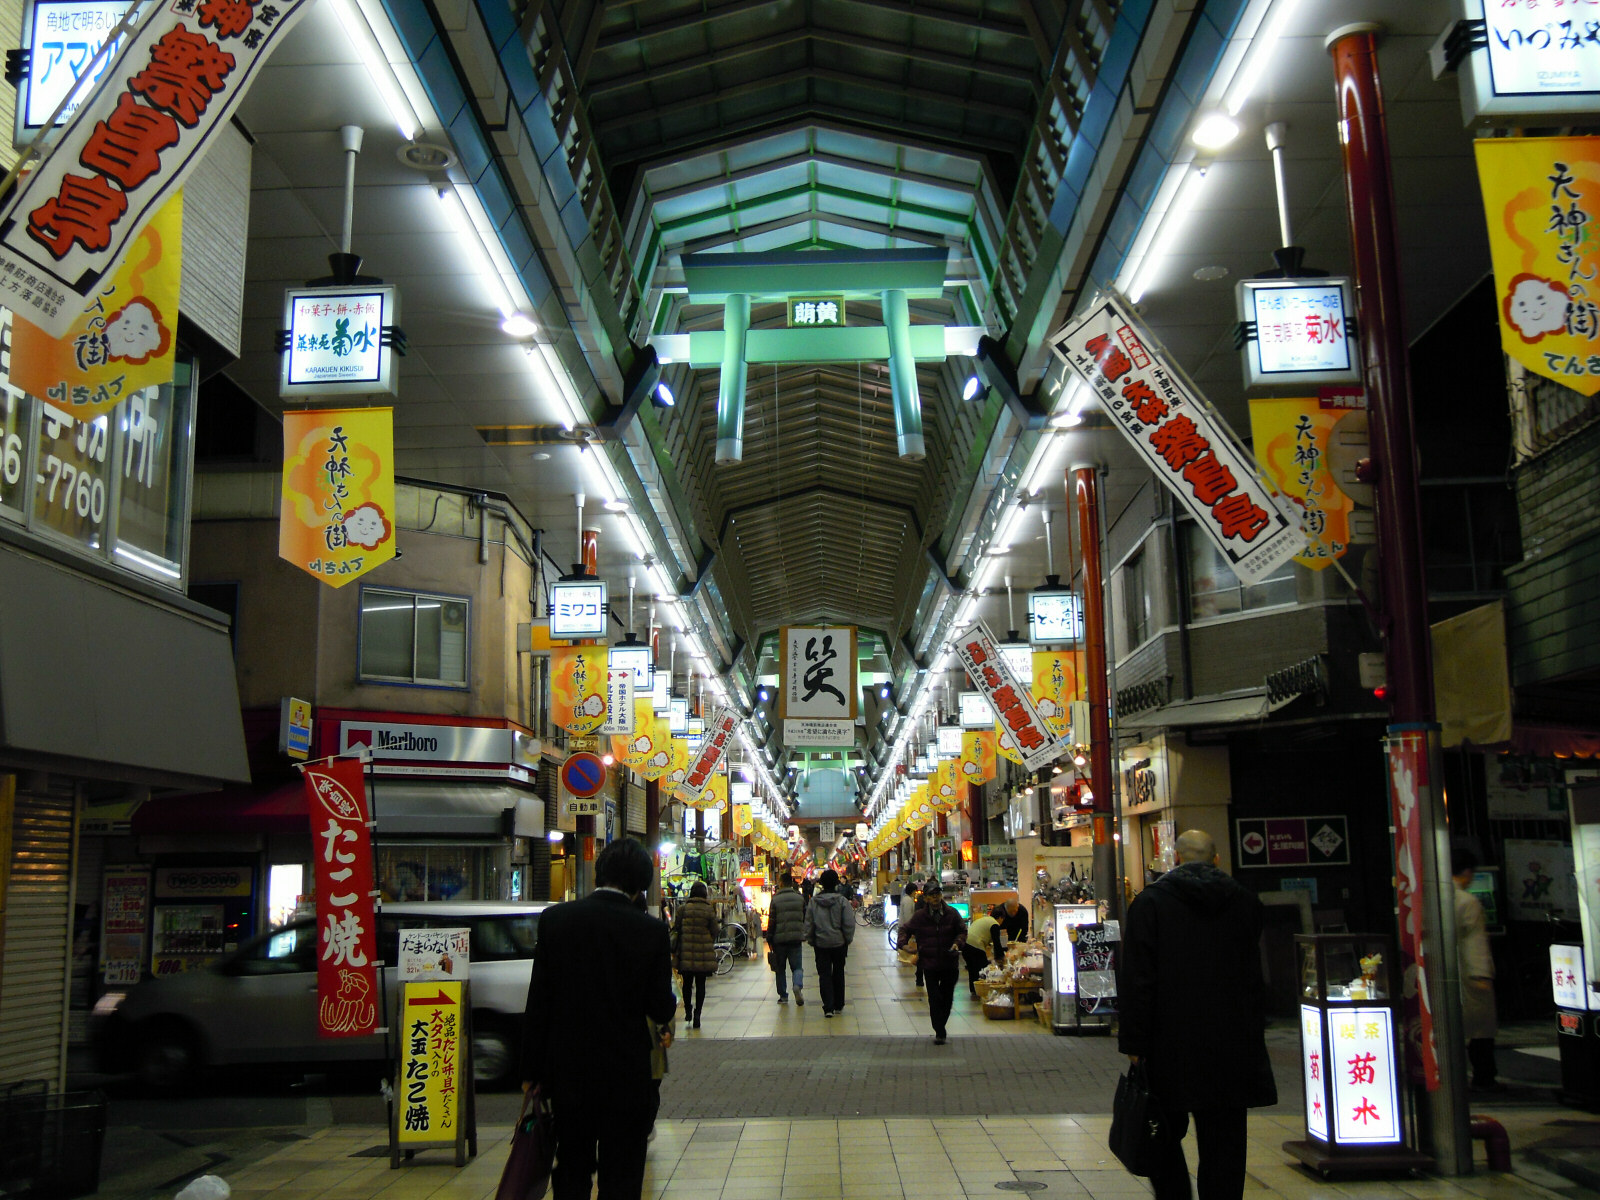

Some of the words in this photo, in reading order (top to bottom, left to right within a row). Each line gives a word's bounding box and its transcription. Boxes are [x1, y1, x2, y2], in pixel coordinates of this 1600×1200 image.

[305, 366, 338, 374] KARAKUEN
[560, 603, 597, 617] ミワコ
[378, 730, 438, 752] Marlboro
[569, 803, 599, 812] 自動車
[320, 819, 368, 968] たこ焼
[405, 1019, 430, 1132] 大玉たこ焼
[1347, 1051, 1381, 1126] 菊水
